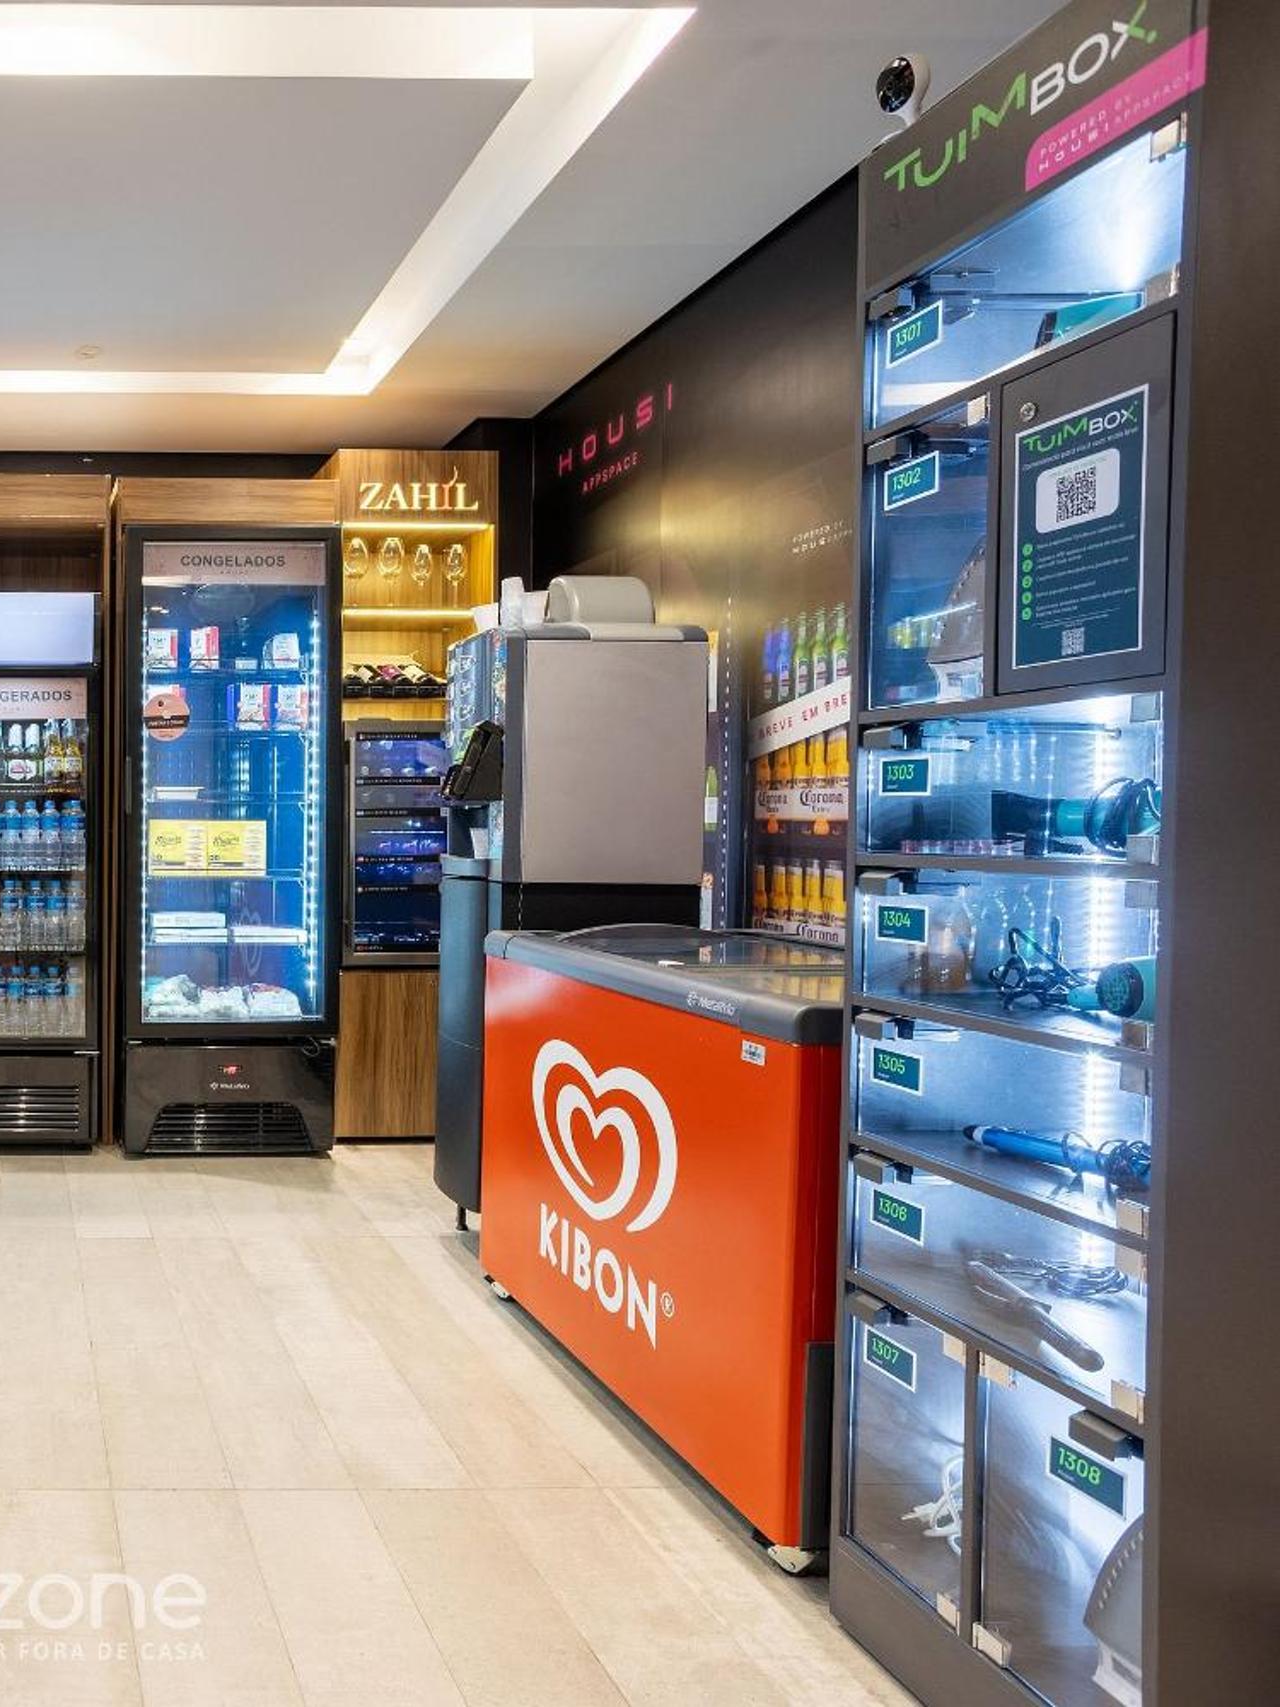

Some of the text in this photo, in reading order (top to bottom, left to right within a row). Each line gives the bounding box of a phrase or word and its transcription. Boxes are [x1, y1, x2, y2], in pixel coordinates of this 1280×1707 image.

[883, 0, 1158, 191] TUIMBOX
[1039, 109, 1107, 158] POWERED
[895, 321, 921, 349] 1301
[557, 381, 673, 477] HOUSI
[581, 451, 639, 495] APPSPACE
[892, 467, 921, 491] 1302
[180, 555, 286, 567] CONGELADOS
[887, 763, 914, 781] 1303
[757, 791, 787, 806] Corona
[799, 790, 844, 807] Corona
[883, 911, 910, 927] 1304
[796, 923, 839, 943] Corona
[878, 1053, 906, 1075] 1305
[878, 1197, 907, 1220] 1306
[539, 1202, 657, 1350] KIBON
[871, 1336, 899, 1364] 1307
[1058, 1447, 1101, 1486] 1308
